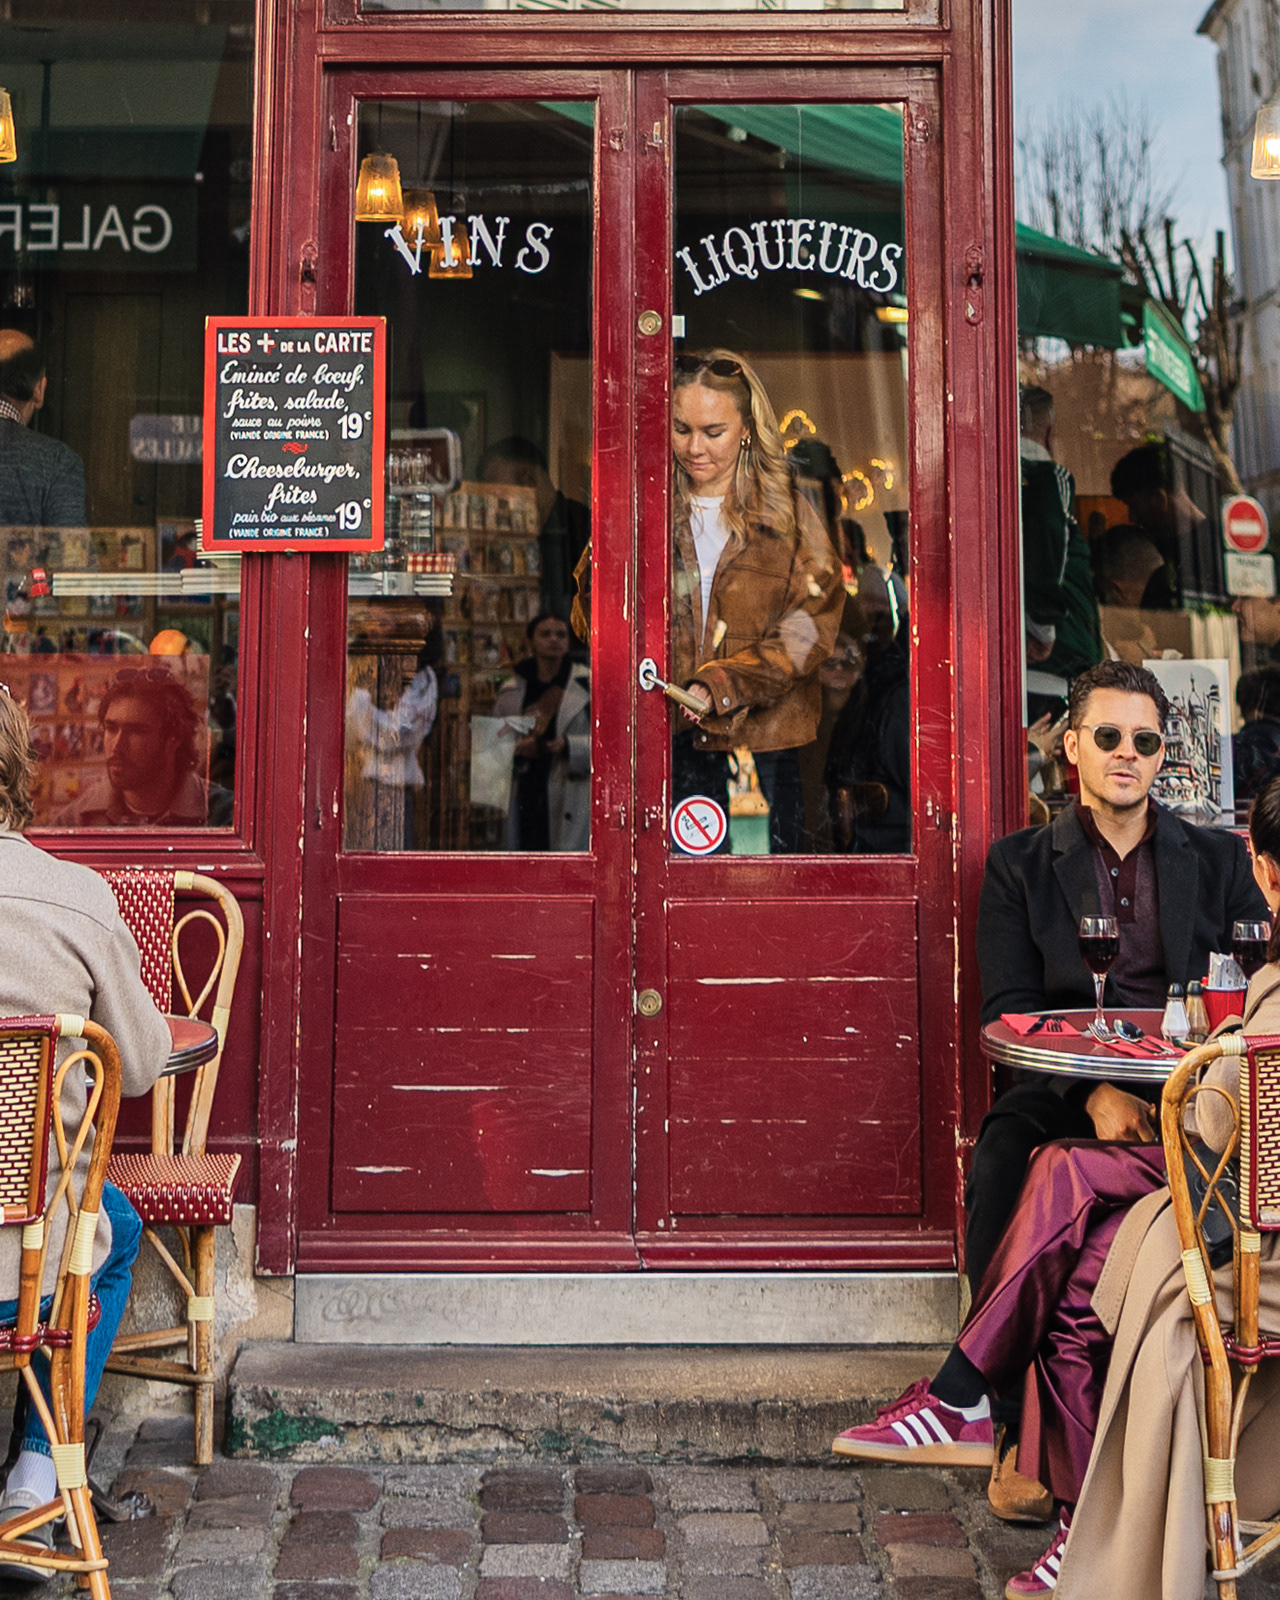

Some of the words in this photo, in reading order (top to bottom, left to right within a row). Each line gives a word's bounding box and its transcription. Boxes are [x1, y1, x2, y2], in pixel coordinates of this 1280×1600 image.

[384, 214, 554, 276] VINS
[676, 218, 903, 296] LIQUEURS
[218, 333, 250, 353] LES
[281, 342, 294, 352] DE
[297, 341, 311, 352] LA
[314, 332, 372, 353] CARTE
[220, 360, 282, 384] Emincé
[285, 364, 307, 384] de
[224, 389, 278, 418] frites,
[284, 390, 348, 411] salade,
[233, 418, 262, 427] sauce
[268, 418, 282, 427] au
[287, 414, 322, 429] poivre
[224, 454, 360, 483] Cheeseburger,
[264, 483, 317, 511] frites
